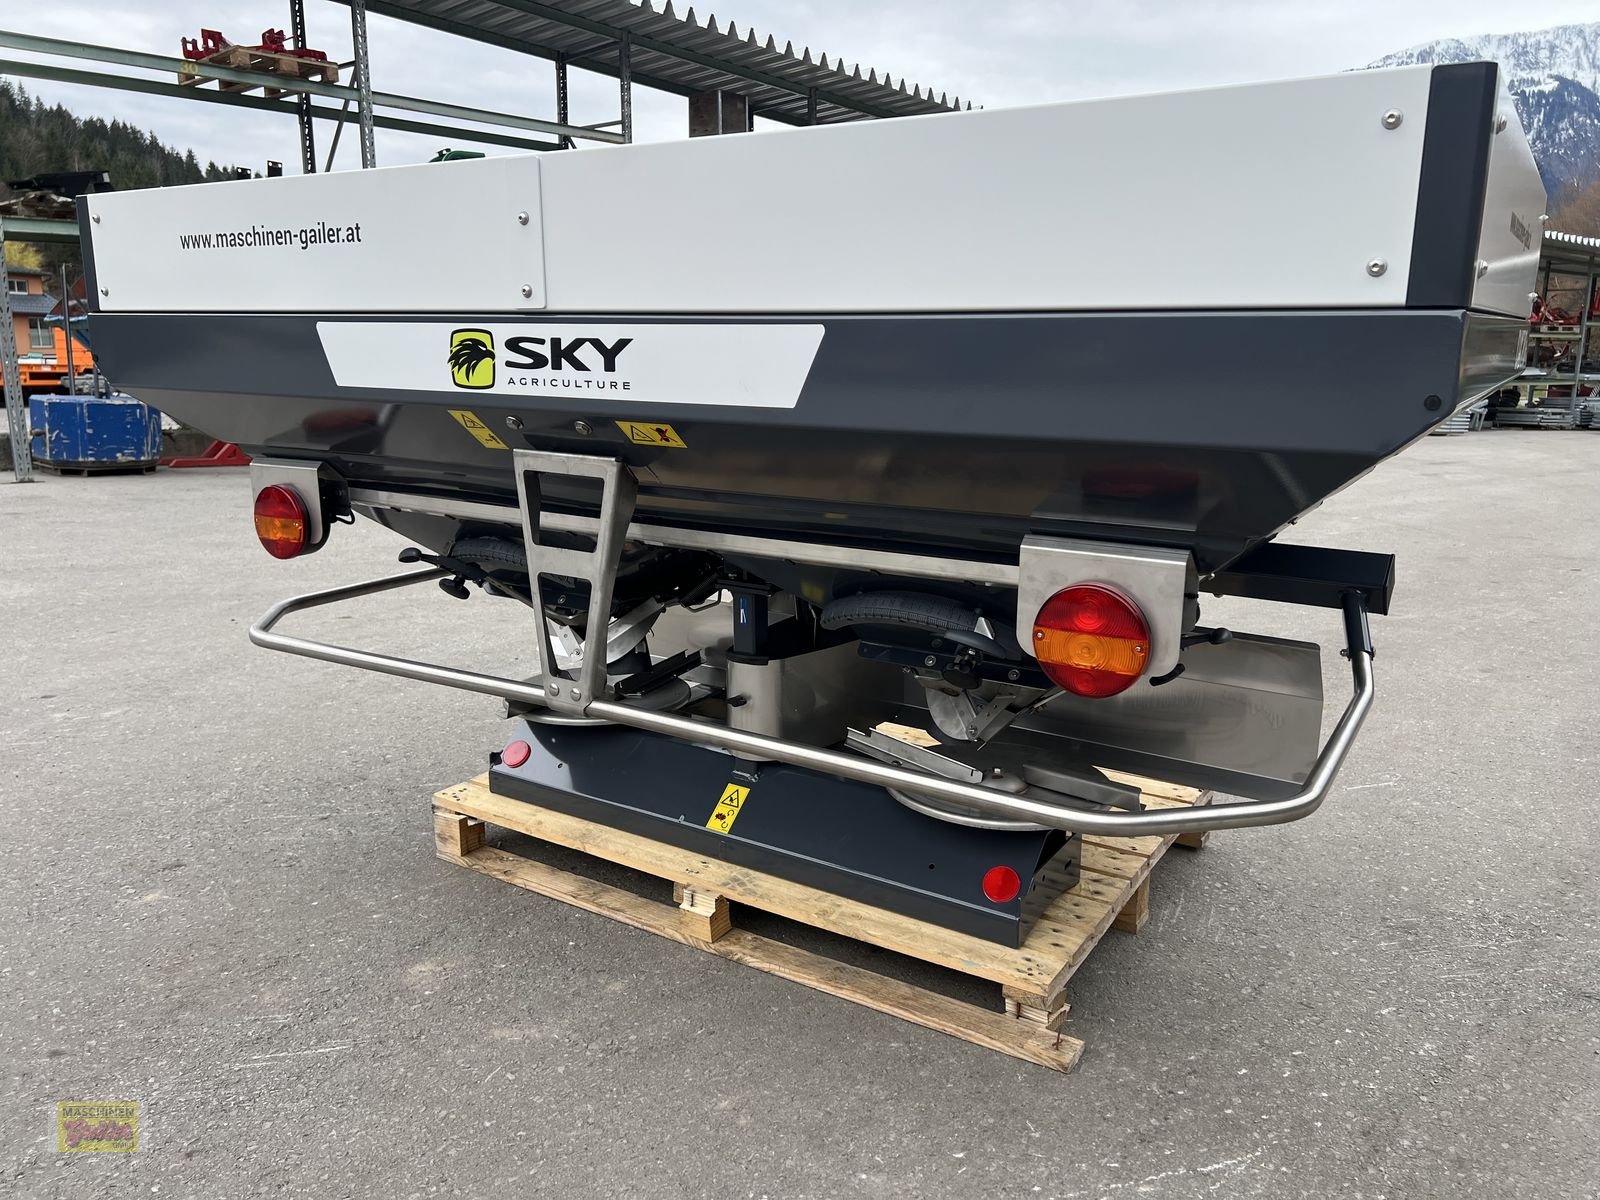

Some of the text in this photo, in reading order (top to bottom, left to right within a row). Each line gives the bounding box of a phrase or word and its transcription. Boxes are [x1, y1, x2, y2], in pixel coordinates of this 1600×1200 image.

[180, 221, 361, 250] www.maschinen-gailer.at
[504, 336, 634, 372] SKY
[507, 377, 631, 390] AGRICULTURE
